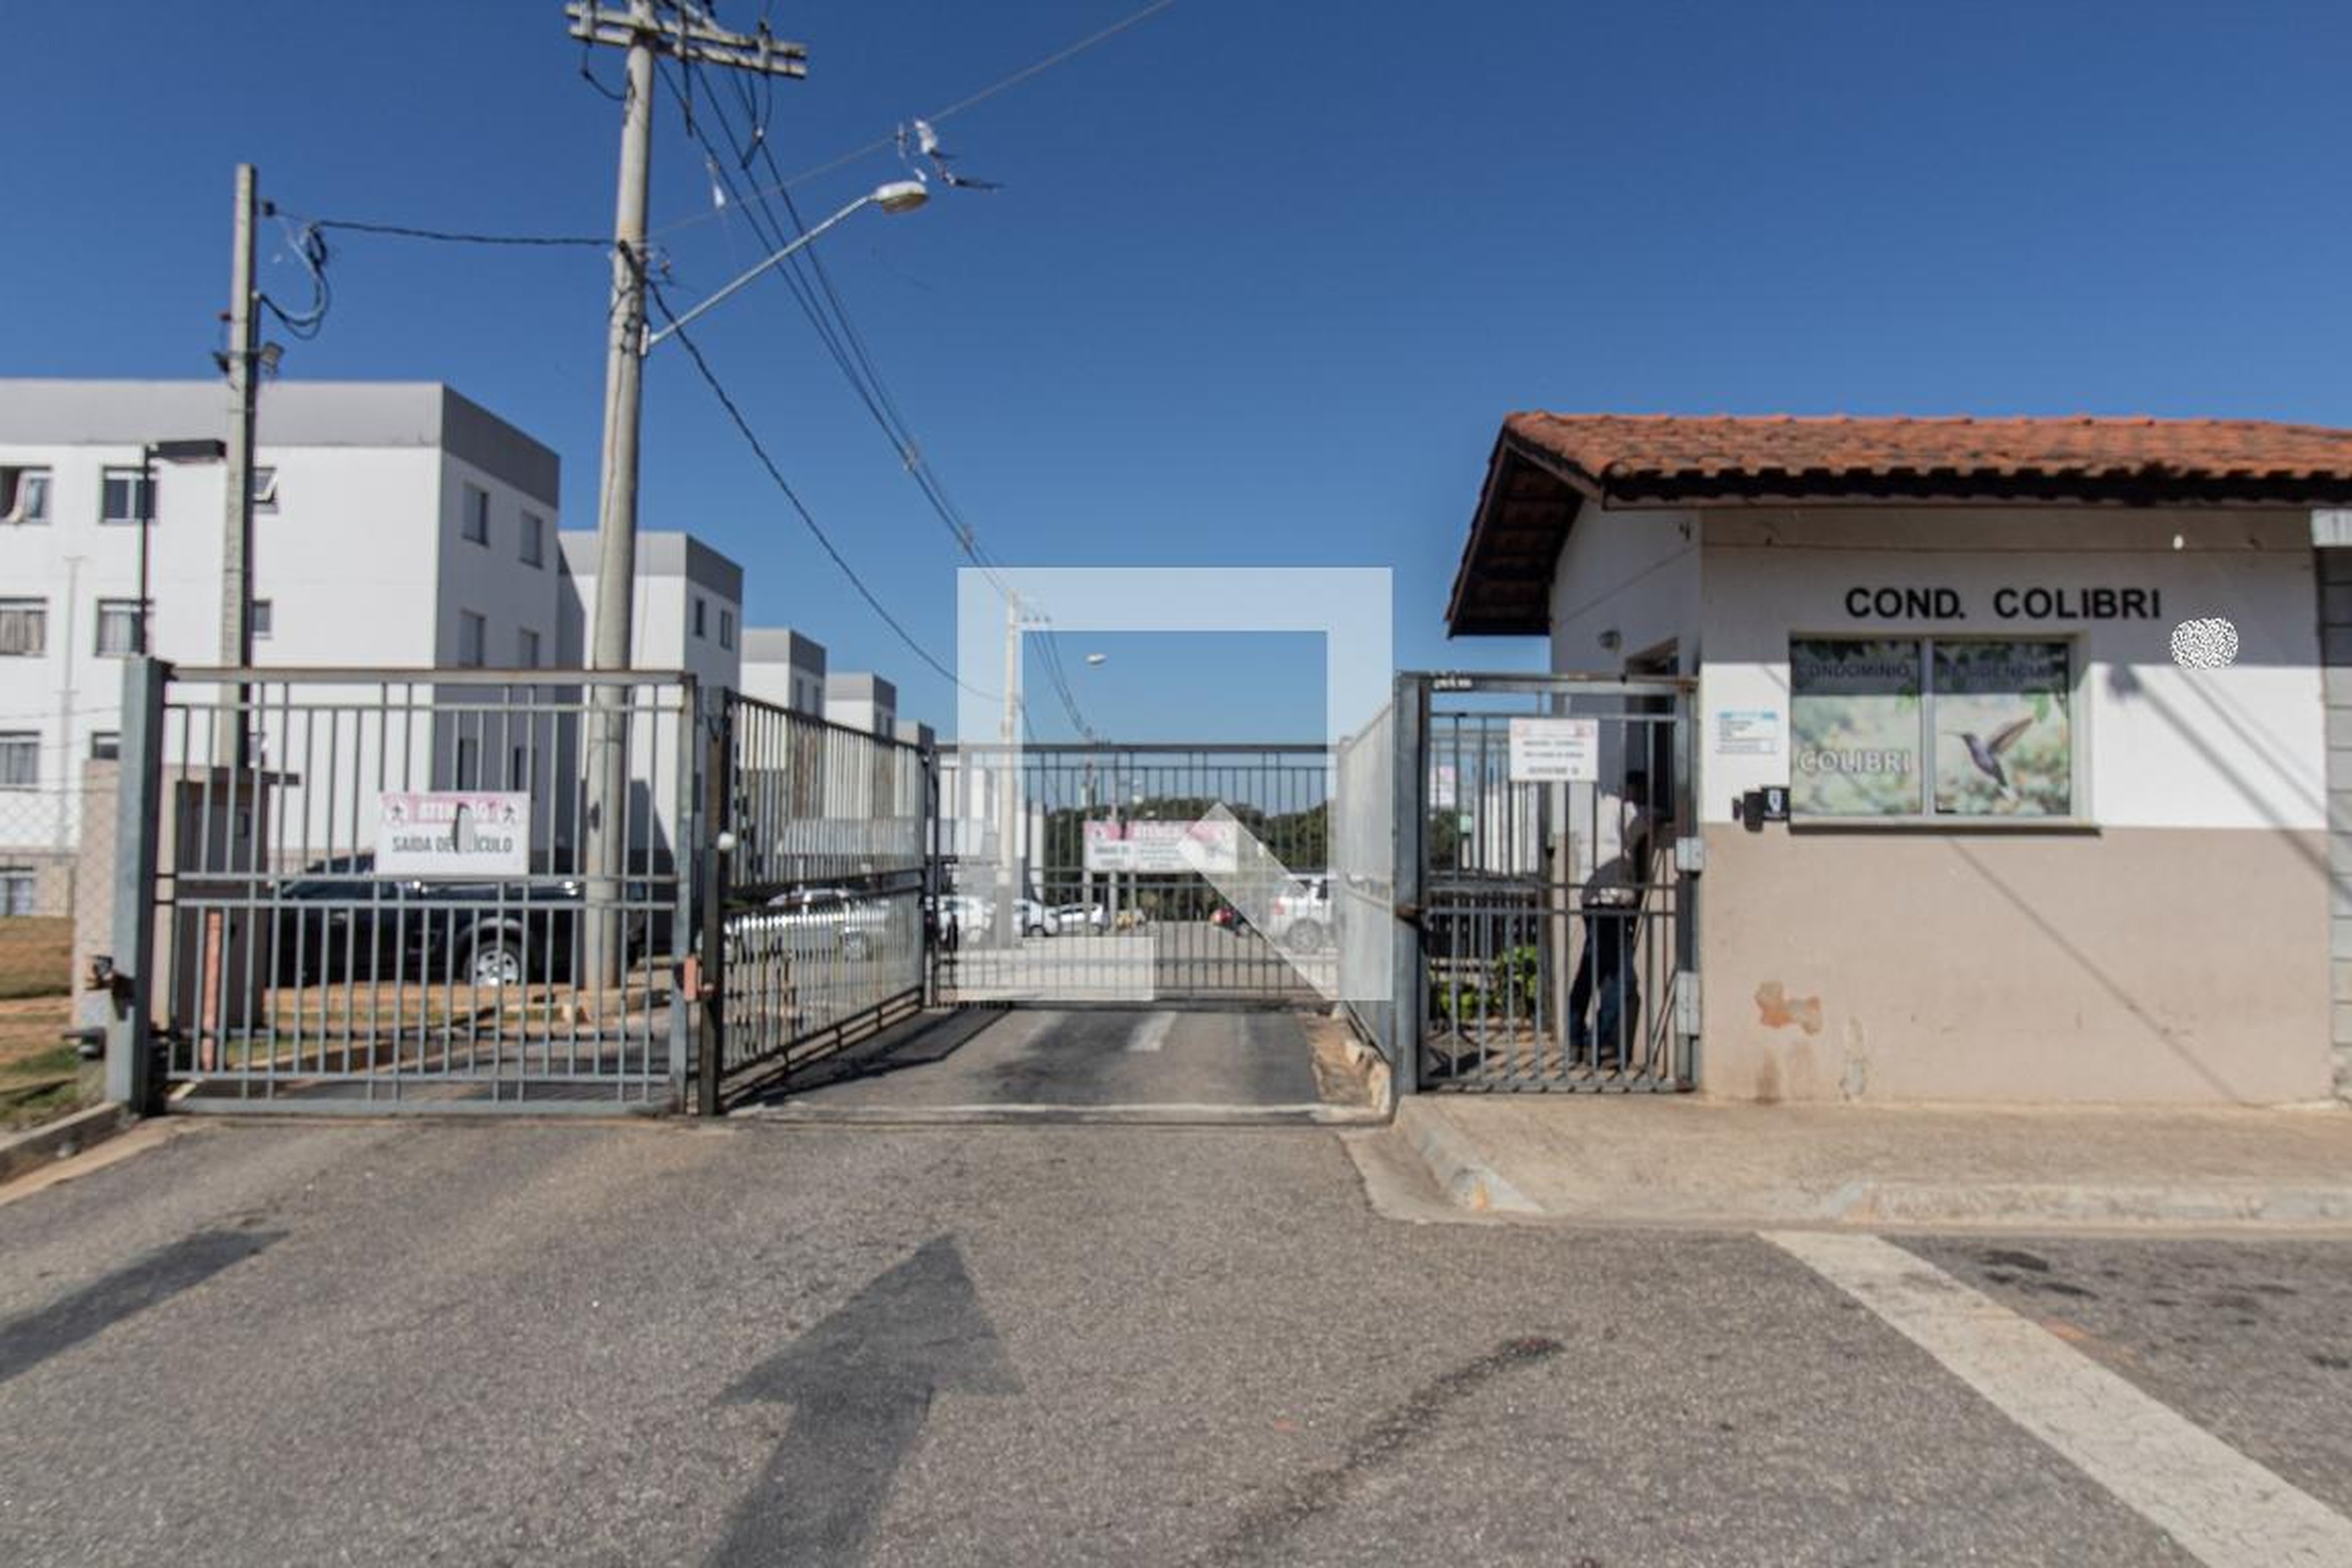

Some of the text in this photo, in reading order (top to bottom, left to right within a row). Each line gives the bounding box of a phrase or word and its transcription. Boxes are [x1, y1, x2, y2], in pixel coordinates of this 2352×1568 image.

[1845, 588, 2161, 619] COND. COLIBRI
[1798, 751, 1912, 774] COLIBRI
[457, 834, 513, 853] ÍCULO
